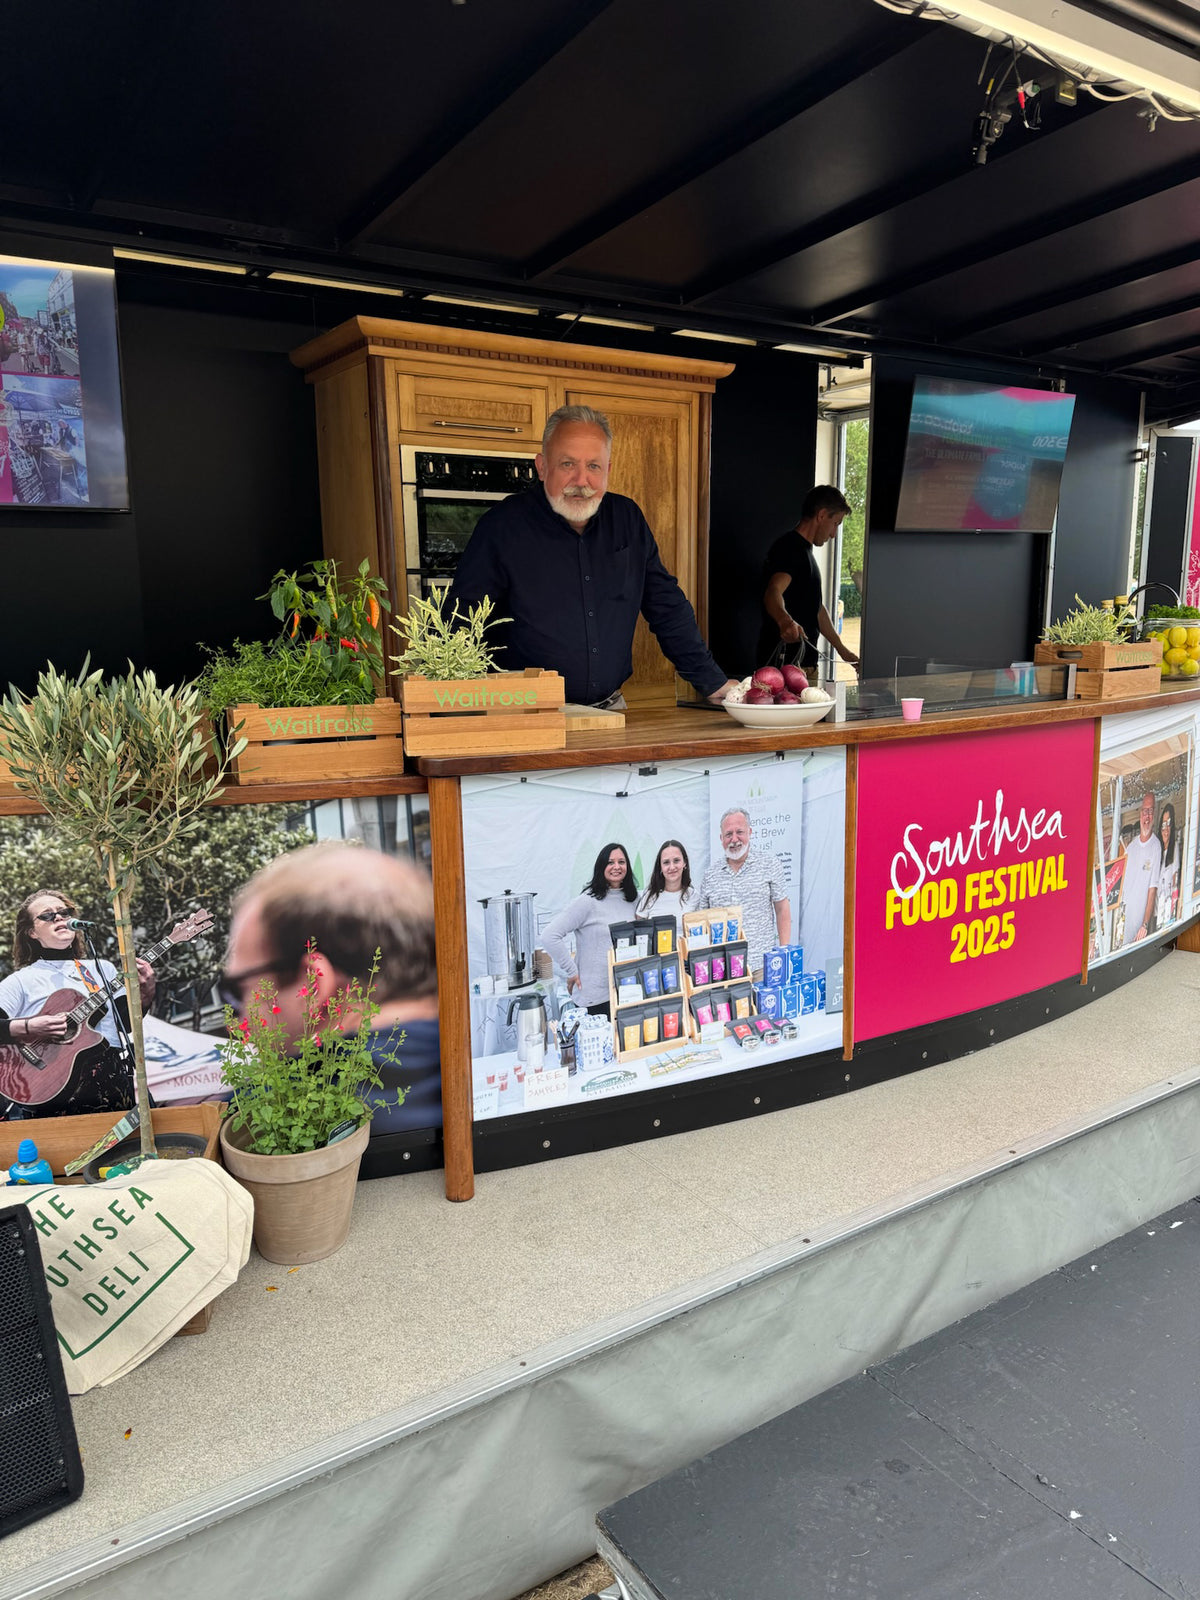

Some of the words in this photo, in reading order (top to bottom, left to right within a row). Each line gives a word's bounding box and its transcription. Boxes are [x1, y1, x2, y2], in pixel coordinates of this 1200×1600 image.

[1115, 651, 1153, 664] Waitrose
[434, 686, 538, 708] Waitrose
[265, 714, 373, 736] Waitrose
[775, 813, 791, 823] the
[762, 828, 785, 838] Brew
[891, 789, 1067, 899] Southsea
[886, 878, 958, 930] FOOD
[965, 853, 1068, 913] FESTIVAL
[950, 911, 1016, 963] 2025
[173, 1072, 226, 1088] MONARC
[528, 1071, 563, 1086] FREE
[528, 1083, 568, 1097] SAMPLES
[33, 1194, 75, 1237] HE
[45, 1187, 153, 1288] UTHSEA
[82, 1251, 149, 1316] DELI
